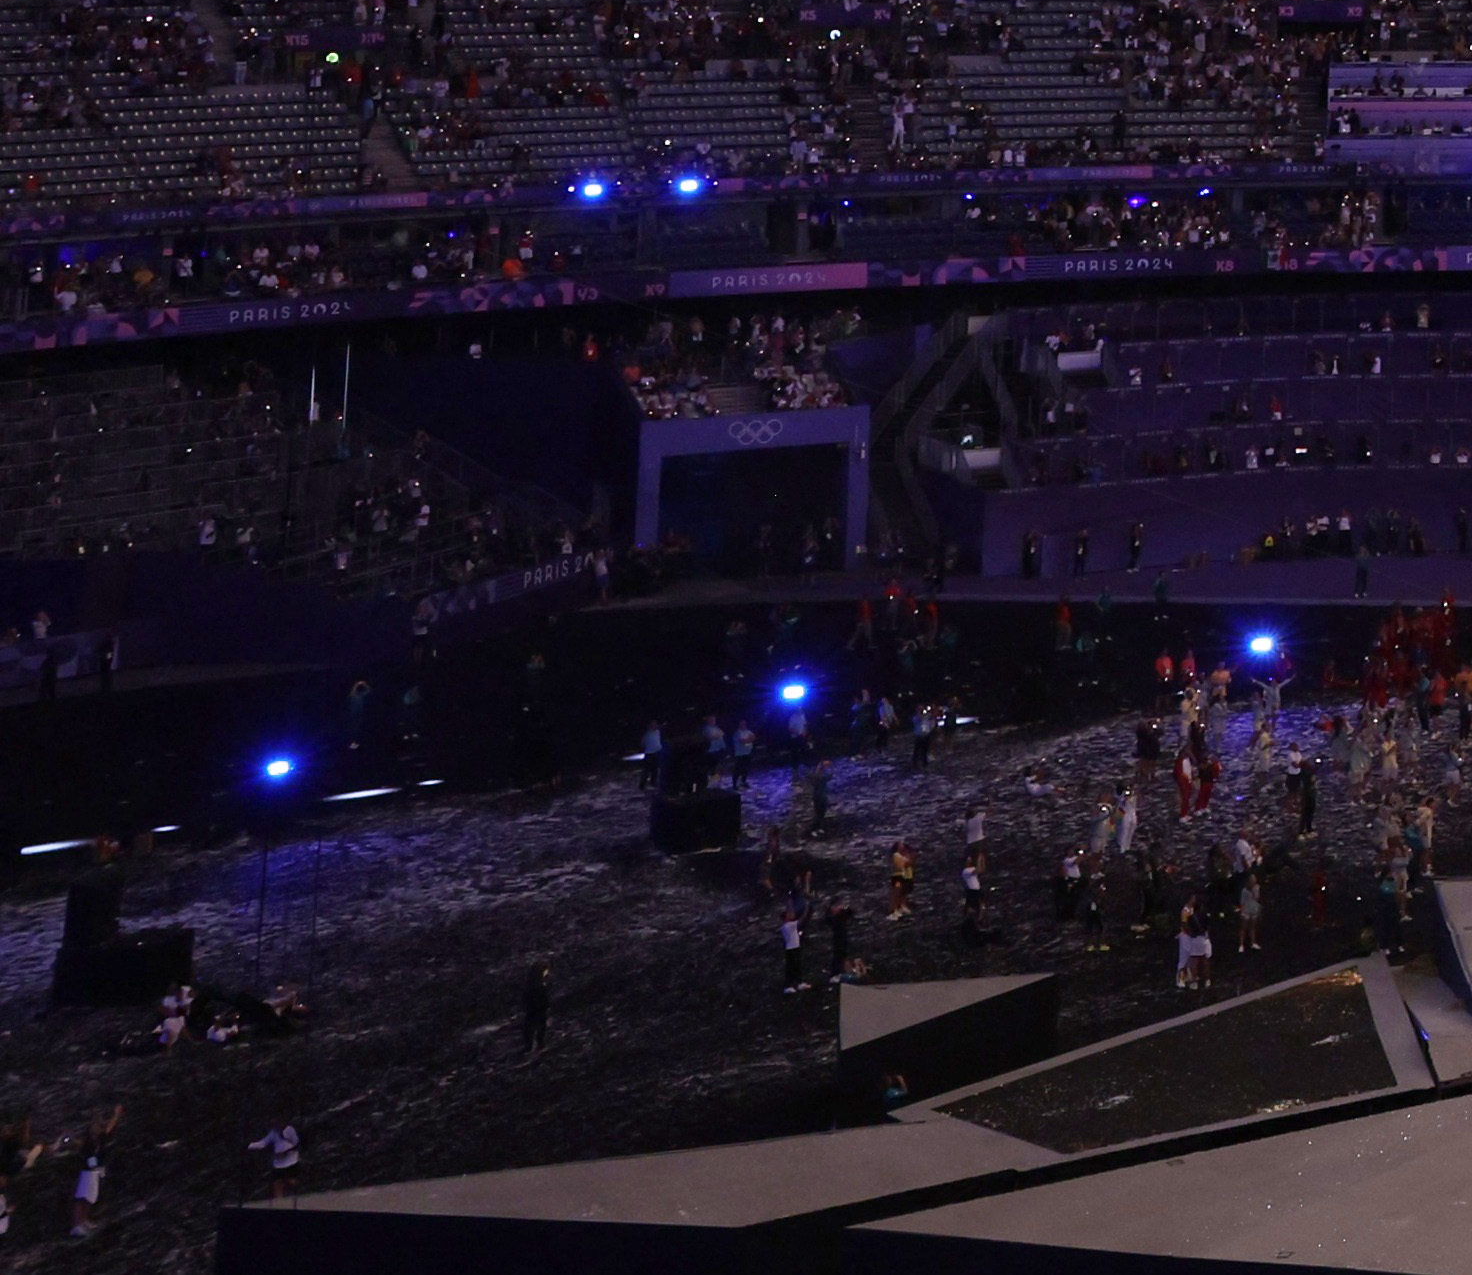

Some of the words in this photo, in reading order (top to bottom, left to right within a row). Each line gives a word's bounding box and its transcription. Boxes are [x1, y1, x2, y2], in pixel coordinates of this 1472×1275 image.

[1278, 6, 1294, 17] X3
[1347, 6, 1362, 17] X2
[1065, 258, 1118, 273] PARIS
[1125, 257, 1174, 271] 2024
[1216, 259, 1234, 272] X8
[712, 273, 768, 289] PARIS
[777, 271, 827, 286] 2024
[229, 305, 291, 324] PARIS
[523, 558, 569, 589] PARIS
